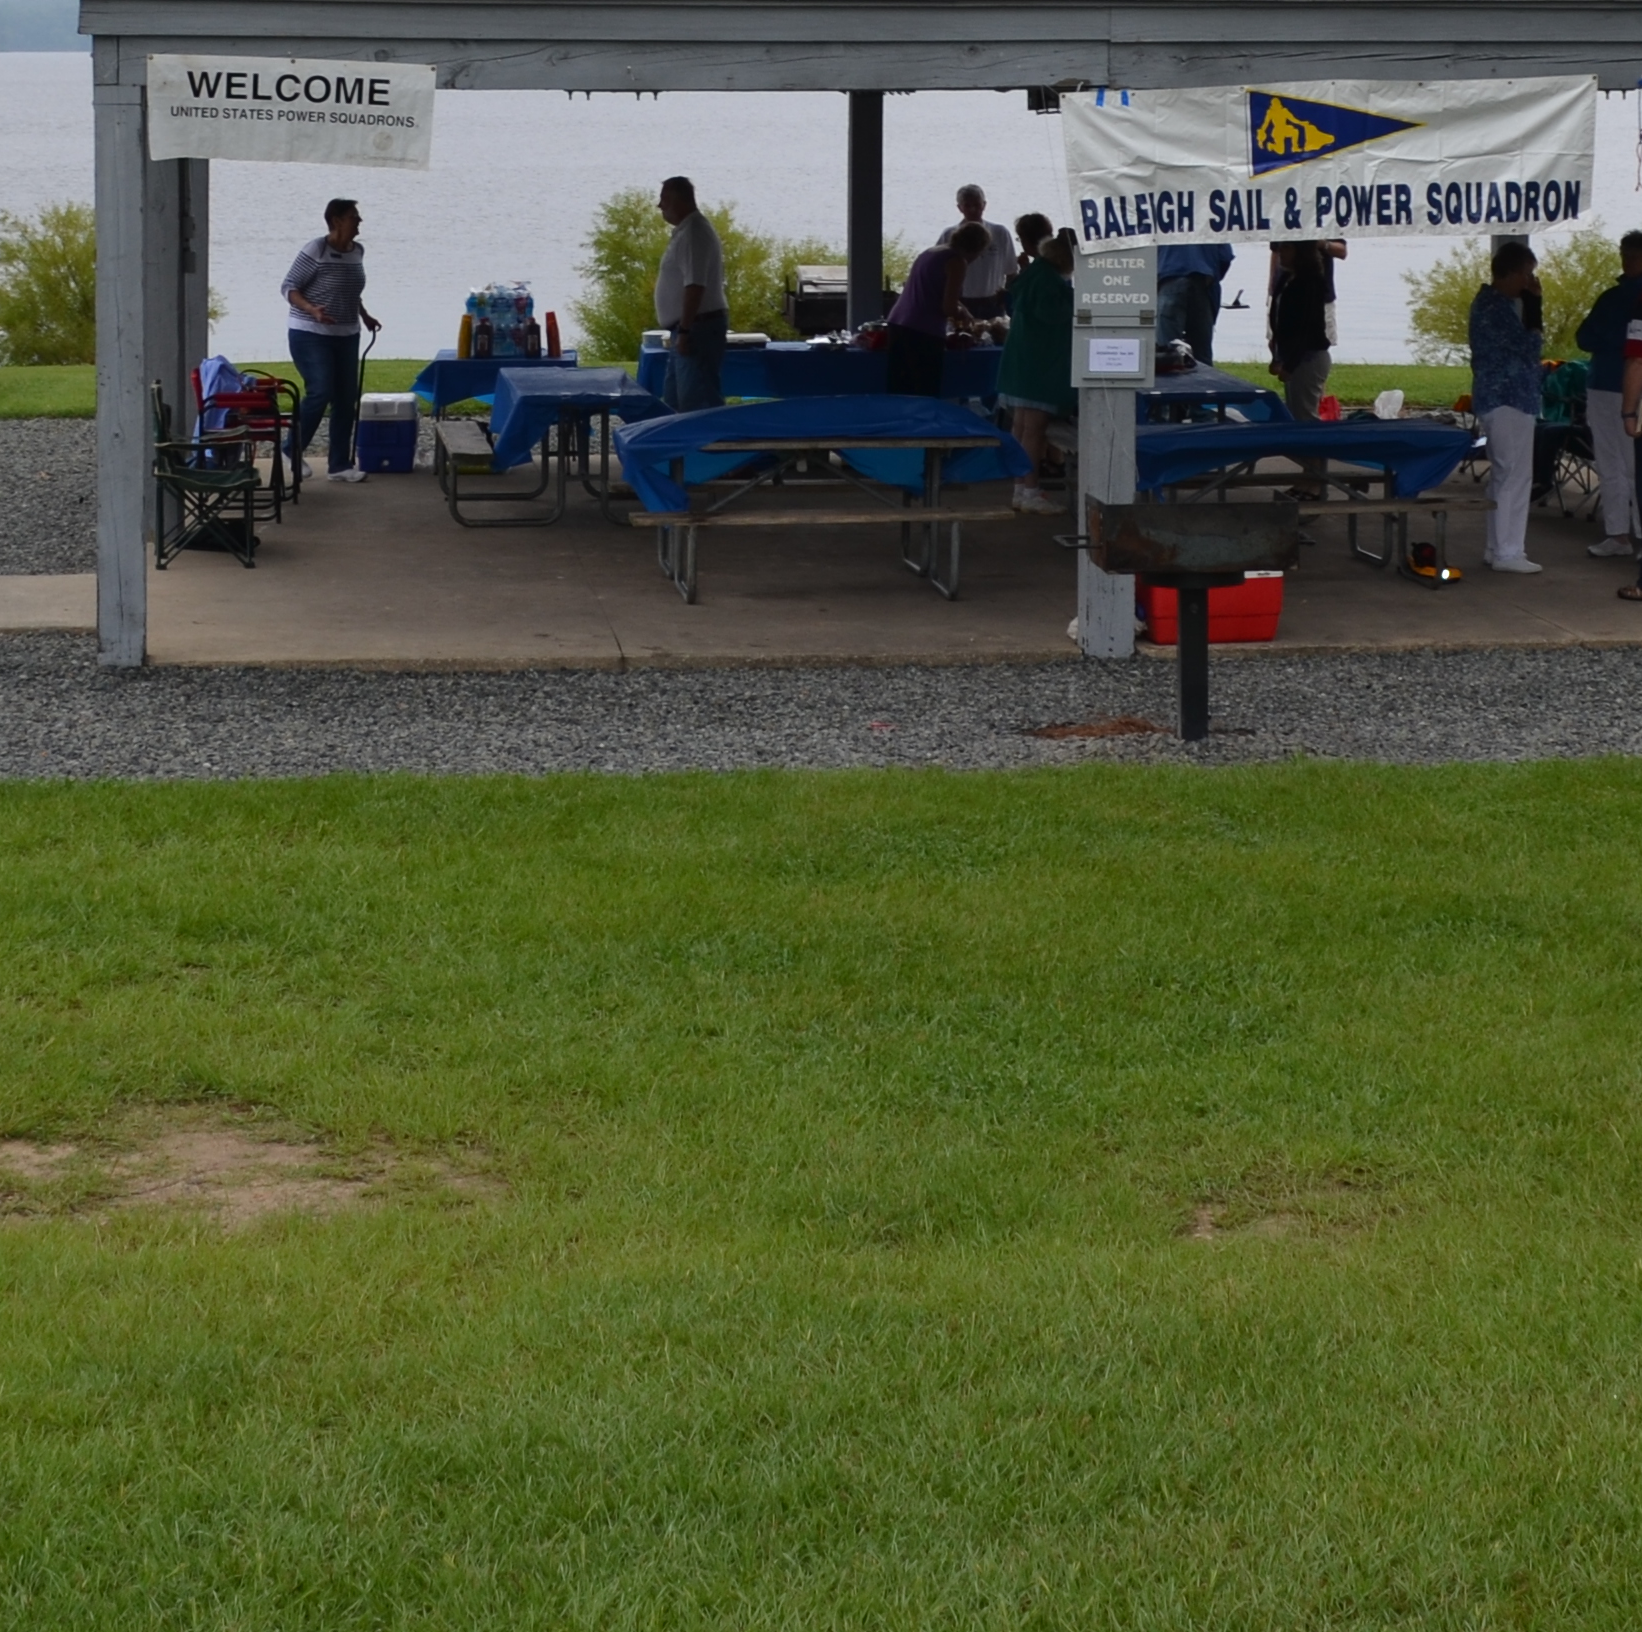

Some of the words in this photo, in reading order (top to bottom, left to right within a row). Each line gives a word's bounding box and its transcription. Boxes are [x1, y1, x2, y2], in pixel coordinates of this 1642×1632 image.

[186, 70, 391, 106] WELCOME
[170, 105, 219, 118] UNITED
[222, 107, 274, 121] STATES
[277, 109, 326, 124] POWER
[1080, 190, 1195, 242] RALEIGH
[1209, 188, 1271, 233] SAIL
[1284, 187, 1302, 231] &
[1315, 183, 1413, 228] POWER
[1426, 179, 1582, 225] SQUADRON
[1087, 257, 1146, 269] SHELTER
[1102, 275, 1131, 286] ONE
[1081, 293, 1150, 304] RESERVED
